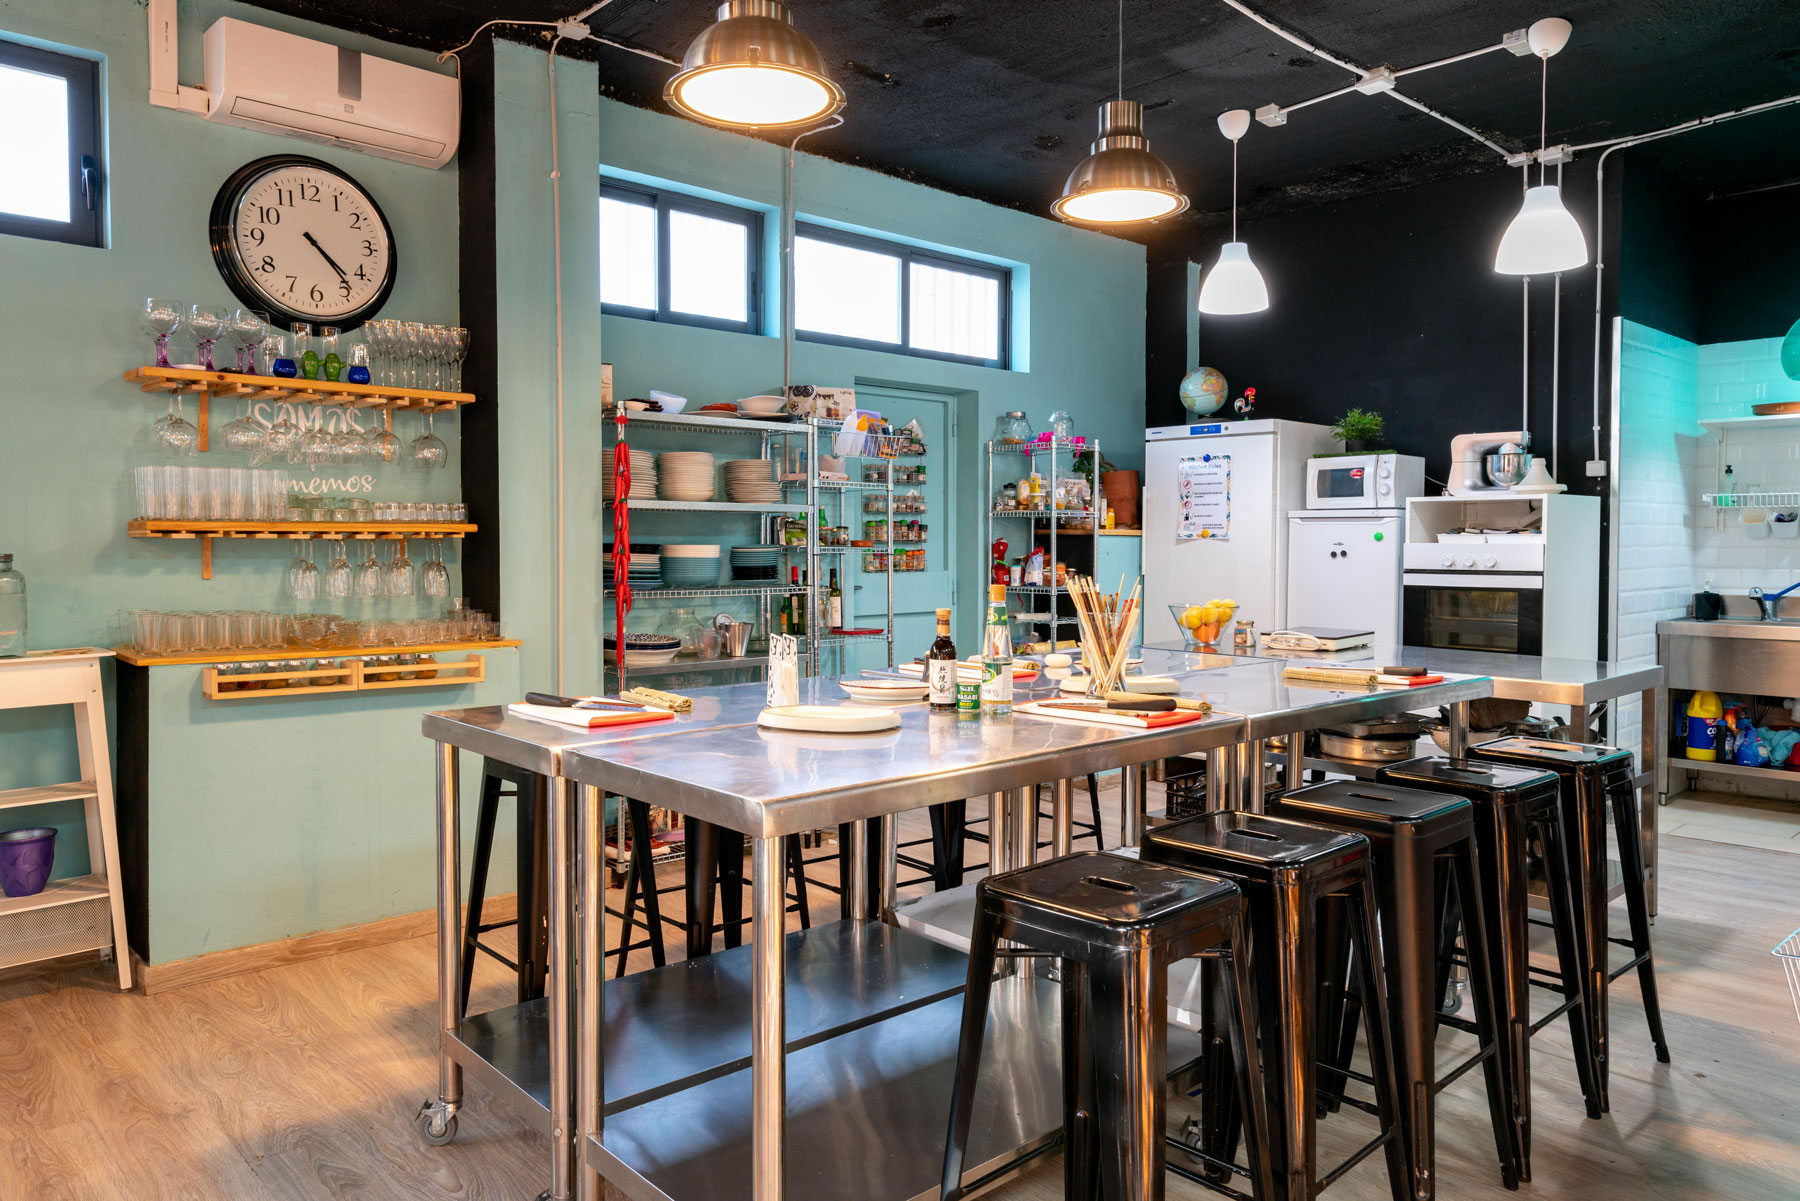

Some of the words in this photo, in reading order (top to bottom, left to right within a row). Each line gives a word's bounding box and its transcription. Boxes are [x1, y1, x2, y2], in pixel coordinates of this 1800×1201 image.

[276, 188, 296, 208] 11
[298, 183, 321, 203] 12
[332, 195, 341, 212] 1
[258, 206, 280, 225] 10
[349, 212, 362, 230] 2
[250, 227, 265, 247] 9
[361, 239, 374, 257] 3
[261, 255, 276, 273] 8
[353, 263, 367, 281] 4
[285, 275, 298, 293] 7
[309, 283, 324, 302] 6
[338, 279, 351, 298] 5
[279, 474, 377, 495] memos
